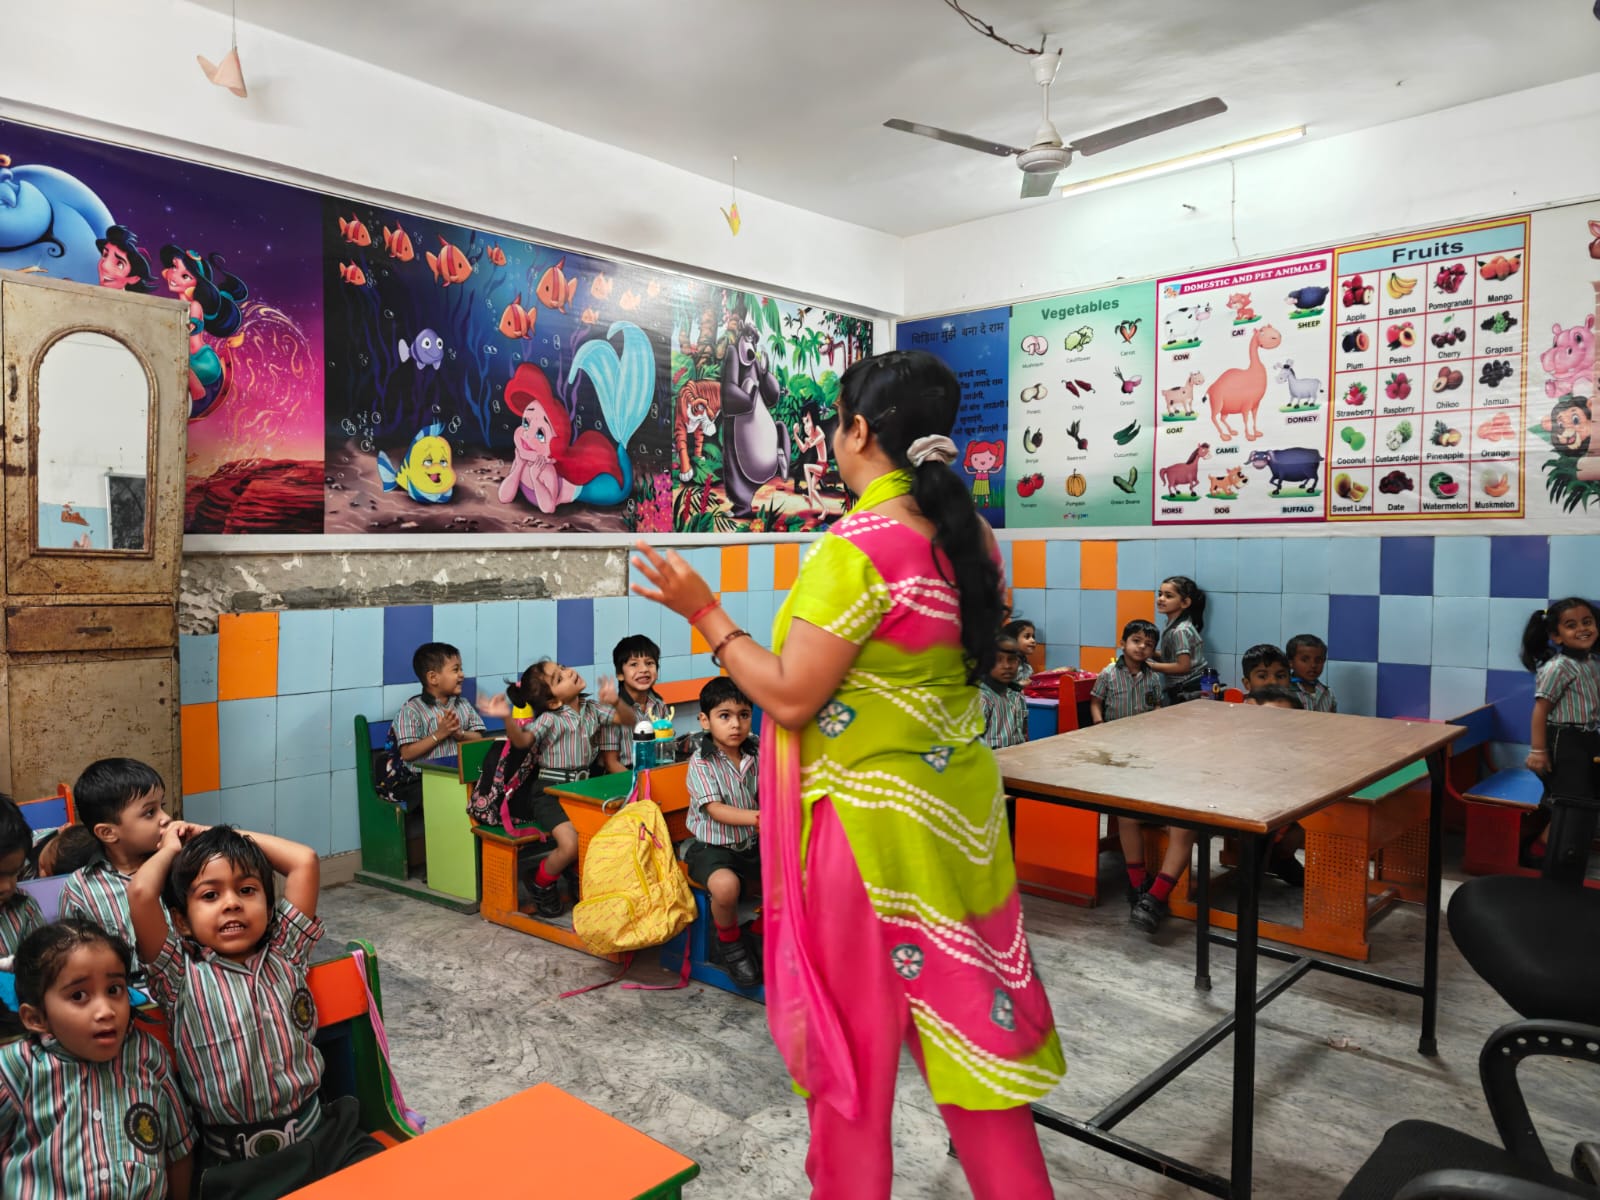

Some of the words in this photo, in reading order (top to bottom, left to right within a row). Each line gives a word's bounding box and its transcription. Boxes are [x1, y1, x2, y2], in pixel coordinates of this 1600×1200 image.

[1392, 241, 1464, 263] Fruits
[1184, 278, 1230, 292] DOMESTIC
[1232, 273, 1252, 284] AND
[1255, 270, 1272, 280] PET
[1274, 262, 1322, 276] ANIMALS
[1488, 293, 1512, 303] Mango
[1428, 298, 1473, 310] Pomegranate
[1041, 299, 1120, 320] Vegetables
[1388, 306, 1416, 316] Banana
[1346, 313, 1366, 323] Apple
[980, 322, 986, 334] दे
[989, 322, 1004, 333] राम
[1298, 320, 1320, 329] SHEEP
[1232, 329, 1244, 337] CAT
[1438, 350, 1460, 360] Cherry
[1485, 346, 1513, 356] Grapes
[1389, 355, 1411, 364] Peach
[1483, 398, 1509, 406] Jamun
[1336, 408, 1374, 417] Strawberry
[1384, 405, 1415, 415] Raspberry
[1287, 416, 1318, 424] DONKEY
[1376, 455, 1400, 463] Custard
[1401, 454, 1419, 462] Apple
[1426, 452, 1464, 461] Pineapple
[1481, 450, 1510, 458] Orange
[1332, 504, 1354, 512] Sweet
[1423, 502, 1468, 510] Watermelon
[1475, 501, 1515, 509] Muskmelon
